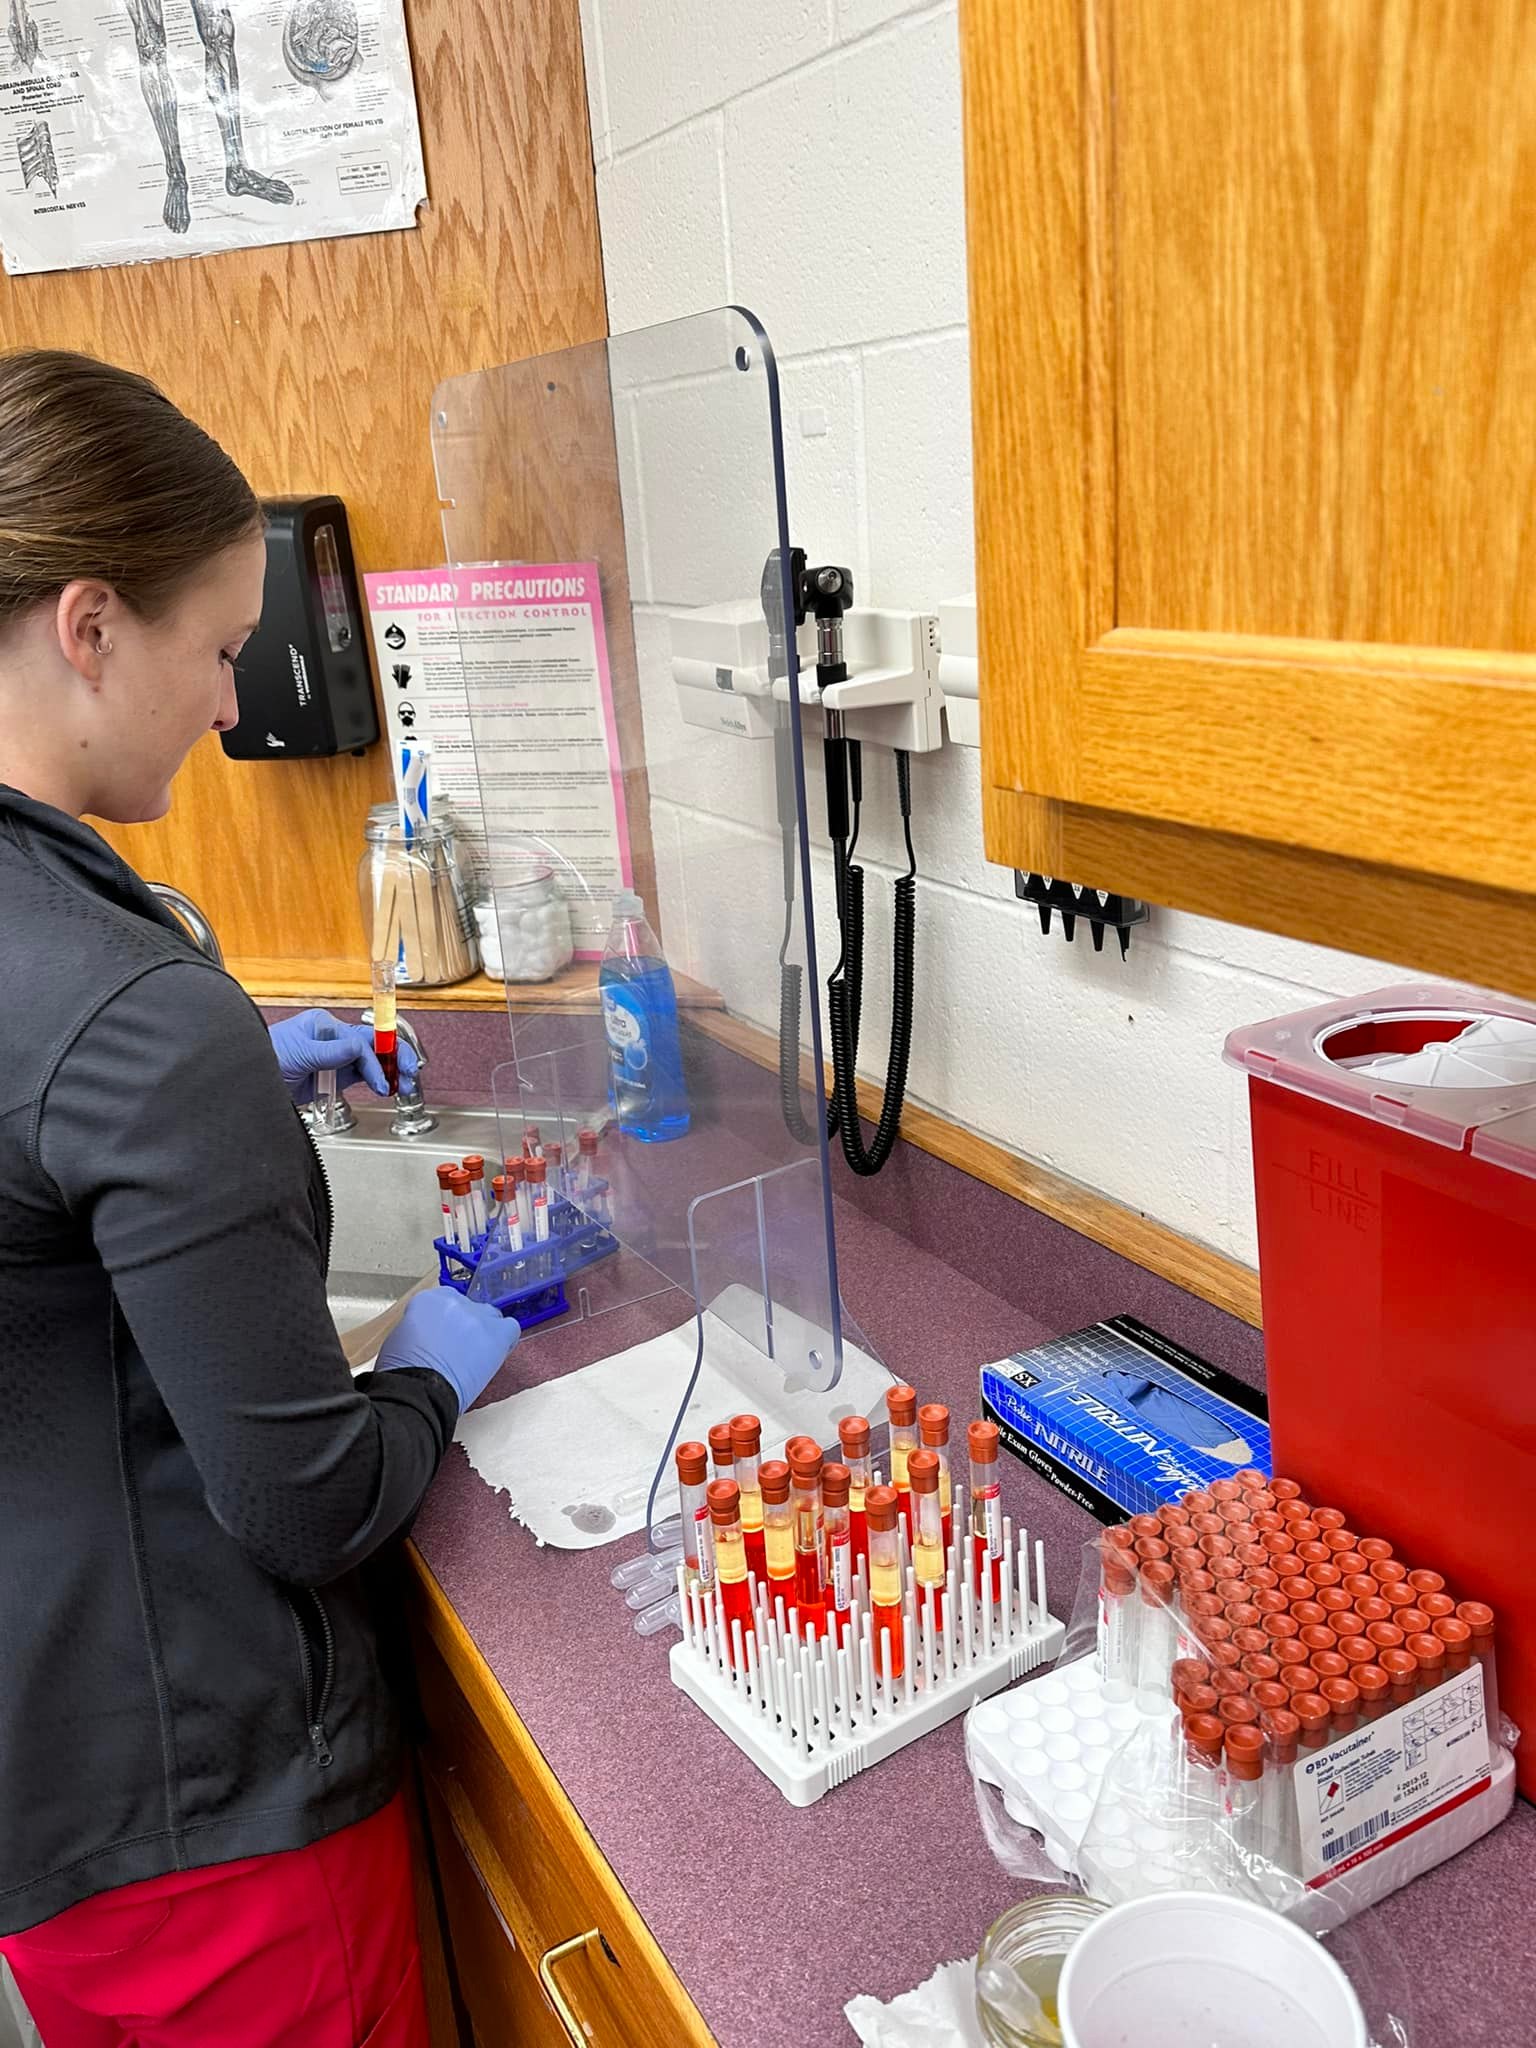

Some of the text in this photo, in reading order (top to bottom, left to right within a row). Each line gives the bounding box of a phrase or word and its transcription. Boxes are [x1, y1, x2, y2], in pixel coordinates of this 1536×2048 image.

[12, 87, 25, 95] AND
[309, 124, 334, 133] SECTION
[334, 122, 341, 130] OF
[342, 120, 364, 129] FEMALE
[364, 118, 384, 126] PELVIS
[33, 201, 87, 215] INTERCOSTAL NERVES
[471, 577, 585, 601] PRECAUTIONS
[418, 612, 440, 622] FOR
[524, 607, 587, 617] CONTROL
[1309, 1148, 1369, 1198] FILL
[1310, 1182, 1368, 1233] LINE
[1014, 1372, 1039, 1388] XS
[1004, 1394, 1034, 1424] Pulse
[1066, 1391, 1172, 1457] NITRILE
[1007, 1433, 1029, 1455] Exam
[1028, 1449, 1053, 1474] Gloves
[1033, 1421, 1110, 1487] NITRILE
[1315, 1734, 1372, 1769] BD Vacutainer
[1321, 1827, 1334, 1840] 100
